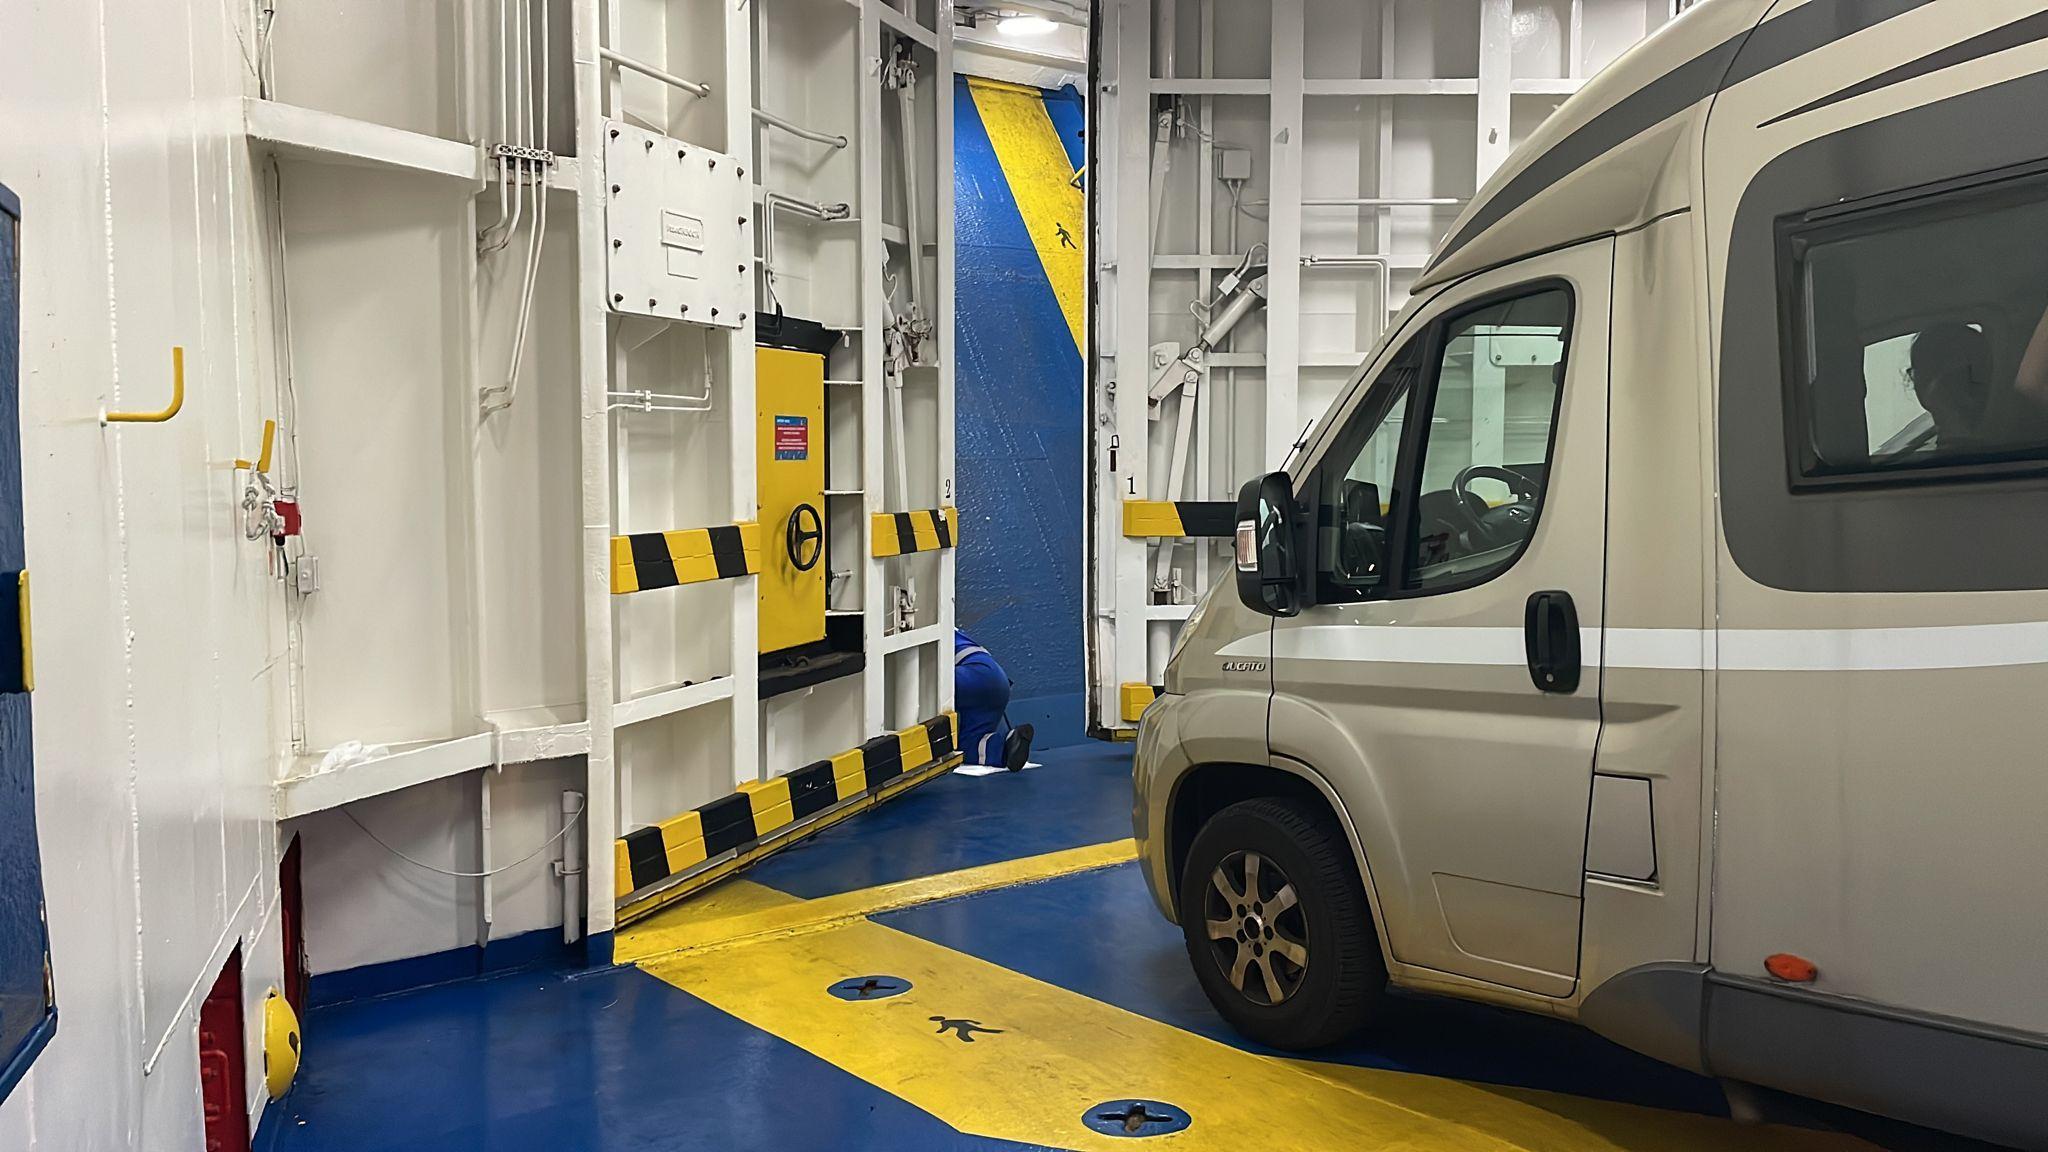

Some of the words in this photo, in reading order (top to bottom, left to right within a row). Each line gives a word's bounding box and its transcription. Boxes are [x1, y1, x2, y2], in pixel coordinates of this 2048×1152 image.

[945, 479, 951, 498] 2
[1127, 476, 1136, 495] 1
[1222, 661, 1266, 672] DUCATO
